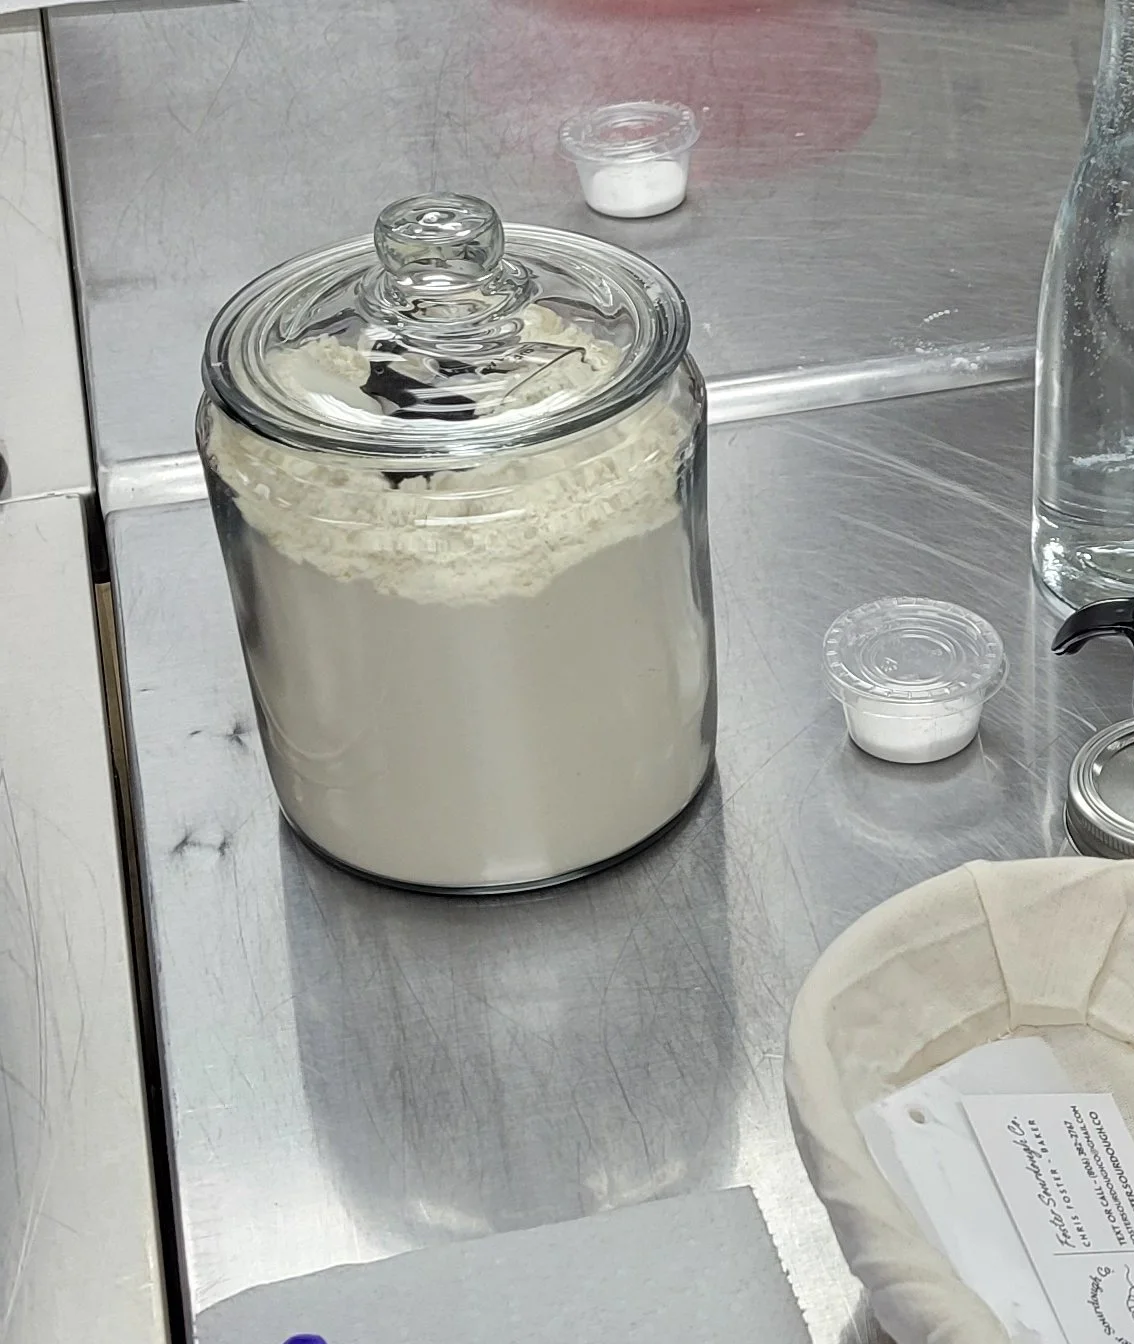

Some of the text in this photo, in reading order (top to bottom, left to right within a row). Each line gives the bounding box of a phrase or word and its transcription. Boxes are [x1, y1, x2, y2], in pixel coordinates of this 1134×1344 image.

[1027, 1119, 1048, 1153] BAKER
[1049, 1168, 1074, 1209] FOSTER
[1093, 1185, 1109, 1206] CALL
[1070, 1215, 1090, 1247] CHRIS
[1103, 1208, 1116, 1223] OR
[1111, 1224, 1127, 1246] TEXT
[1087, 1275, 1115, 1336] Sourdough
